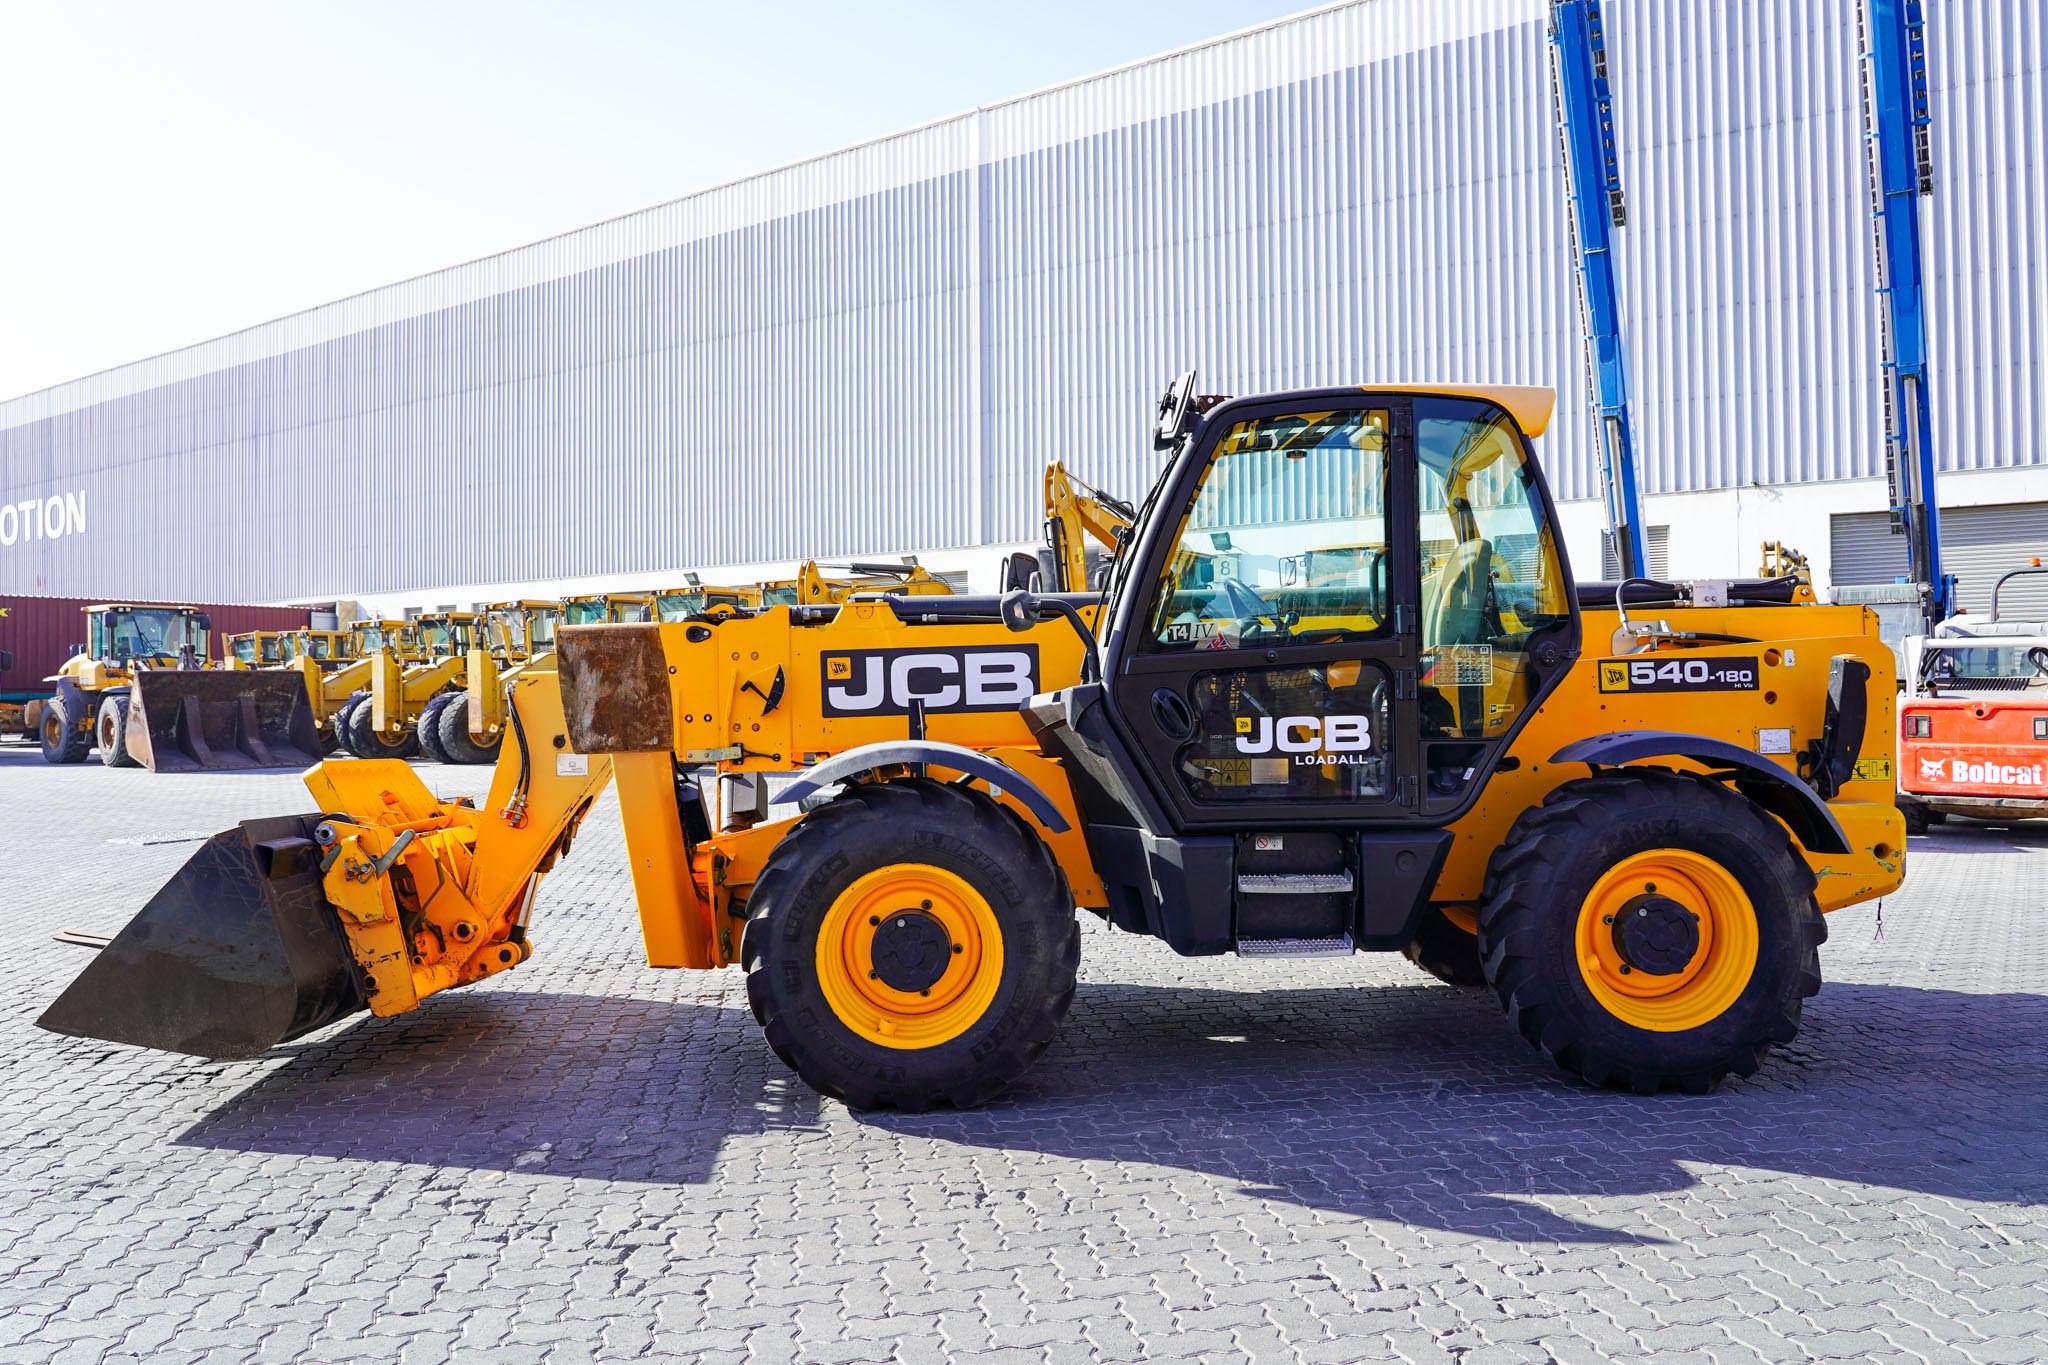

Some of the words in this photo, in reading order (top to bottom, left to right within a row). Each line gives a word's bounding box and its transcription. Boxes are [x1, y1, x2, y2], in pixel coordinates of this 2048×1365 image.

[0, 490, 86, 546] OTION
[1220, 561, 1231, 576] 8
[1194, 623, 1215, 639] IV
[828, 652, 1034, 710] JCB
[1608, 669, 1625, 684] JCB
[1630, 660, 1753, 685] 540-180
[1235, 715, 1371, 753] JCB
[1295, 754, 1368, 766] LOADALL
[1952, 760, 2043, 785] Bobcat
